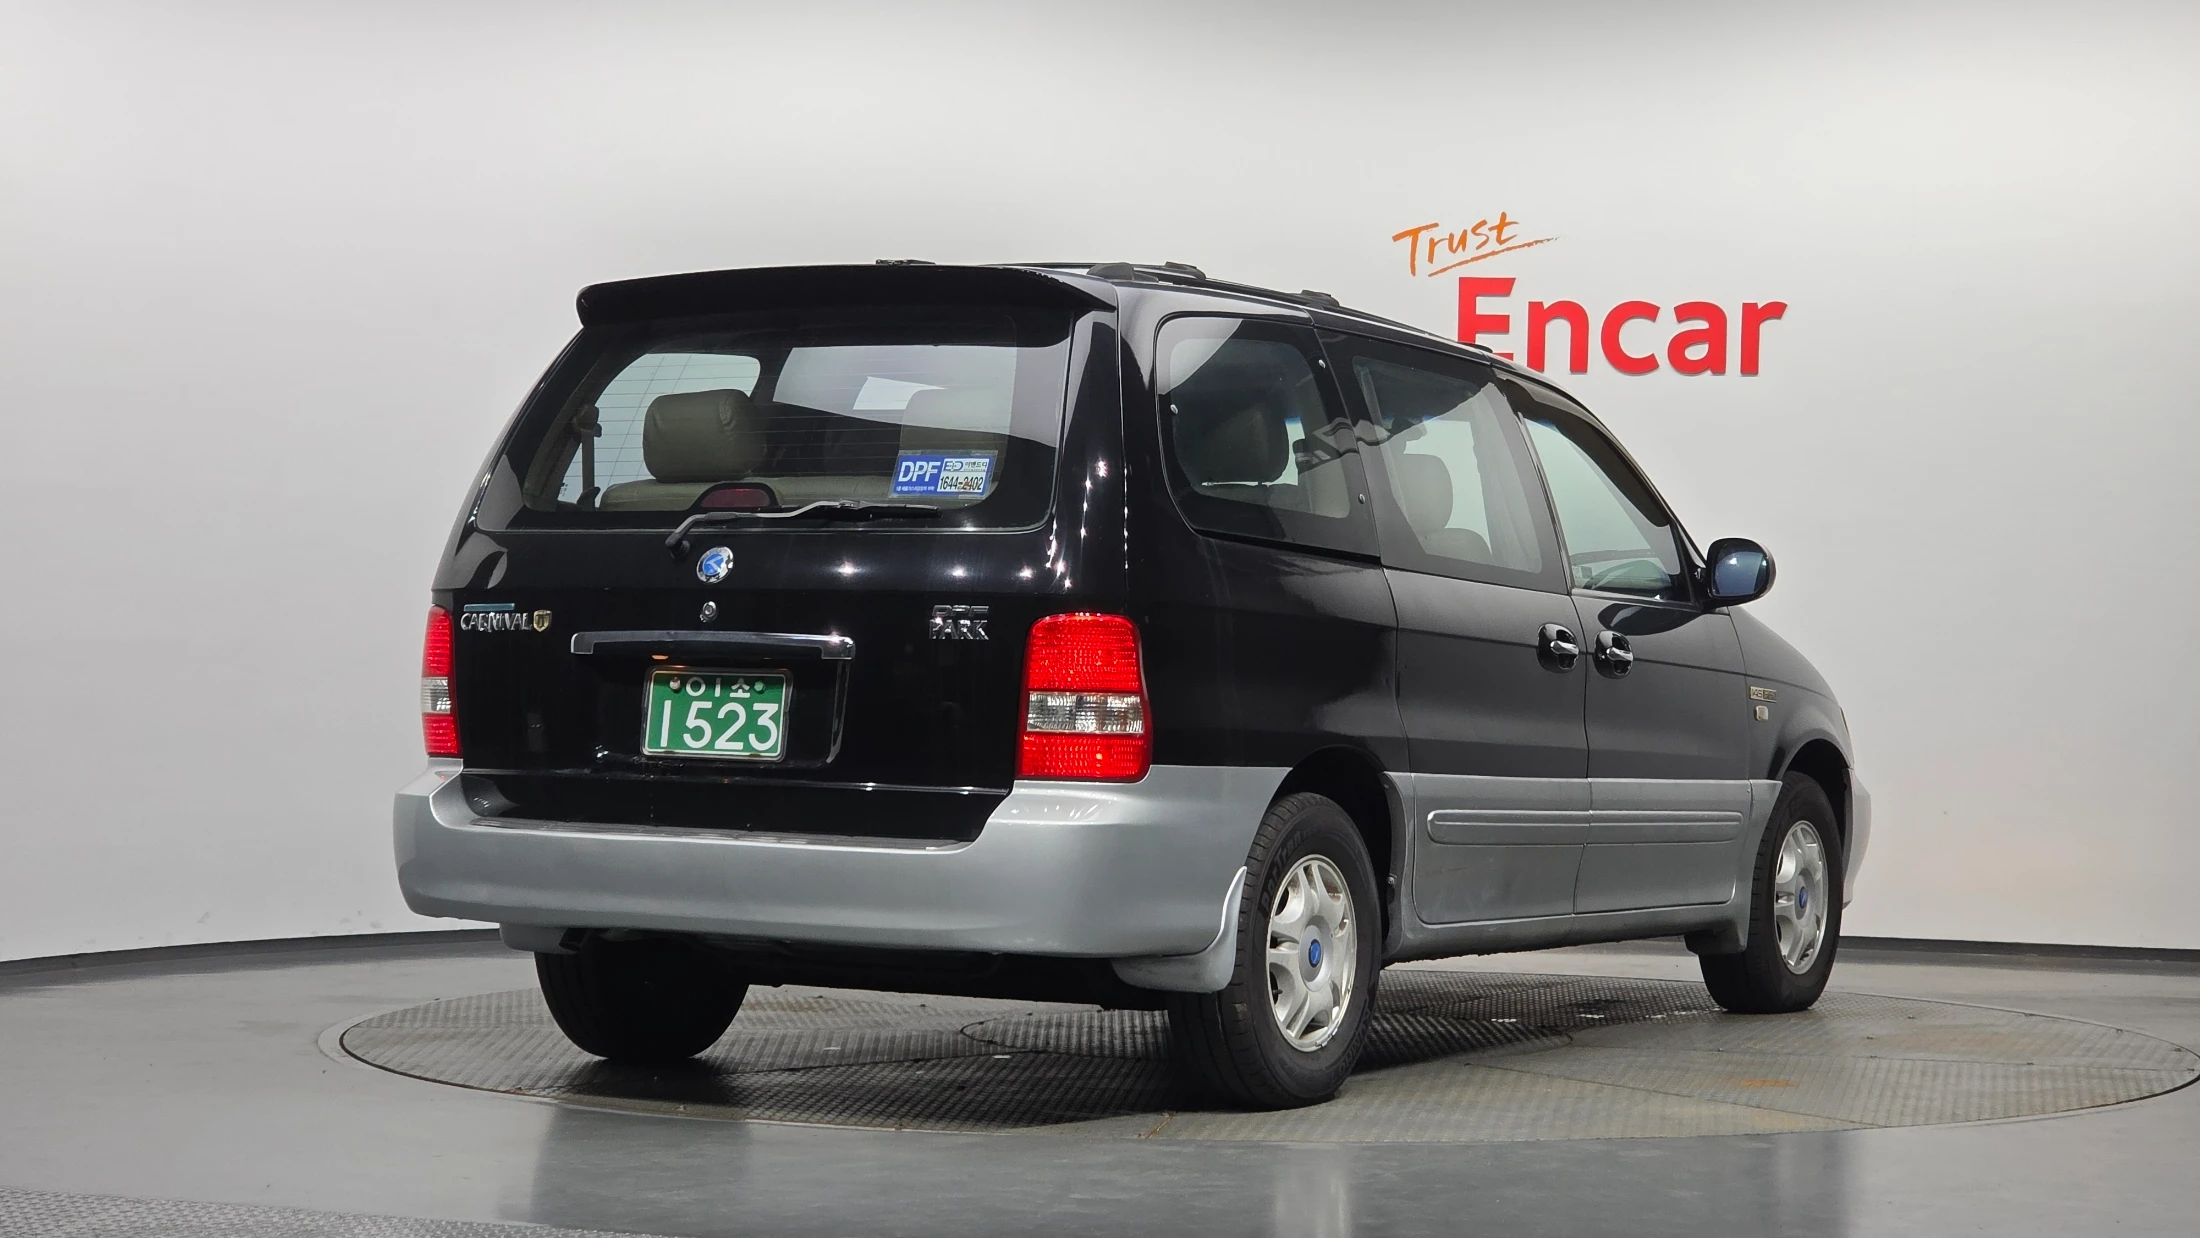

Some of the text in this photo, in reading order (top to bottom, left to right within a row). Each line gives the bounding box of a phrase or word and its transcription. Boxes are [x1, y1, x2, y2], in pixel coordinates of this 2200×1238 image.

[1391, 212, 1519, 277] Trust
[1457, 276, 1789, 376] Encar
[898, 461, 941, 482] DPF
[460, 611, 532, 632] CARNIVAL
[929, 618, 989, 640] PARK
[659, 699, 779, 751] 1523
